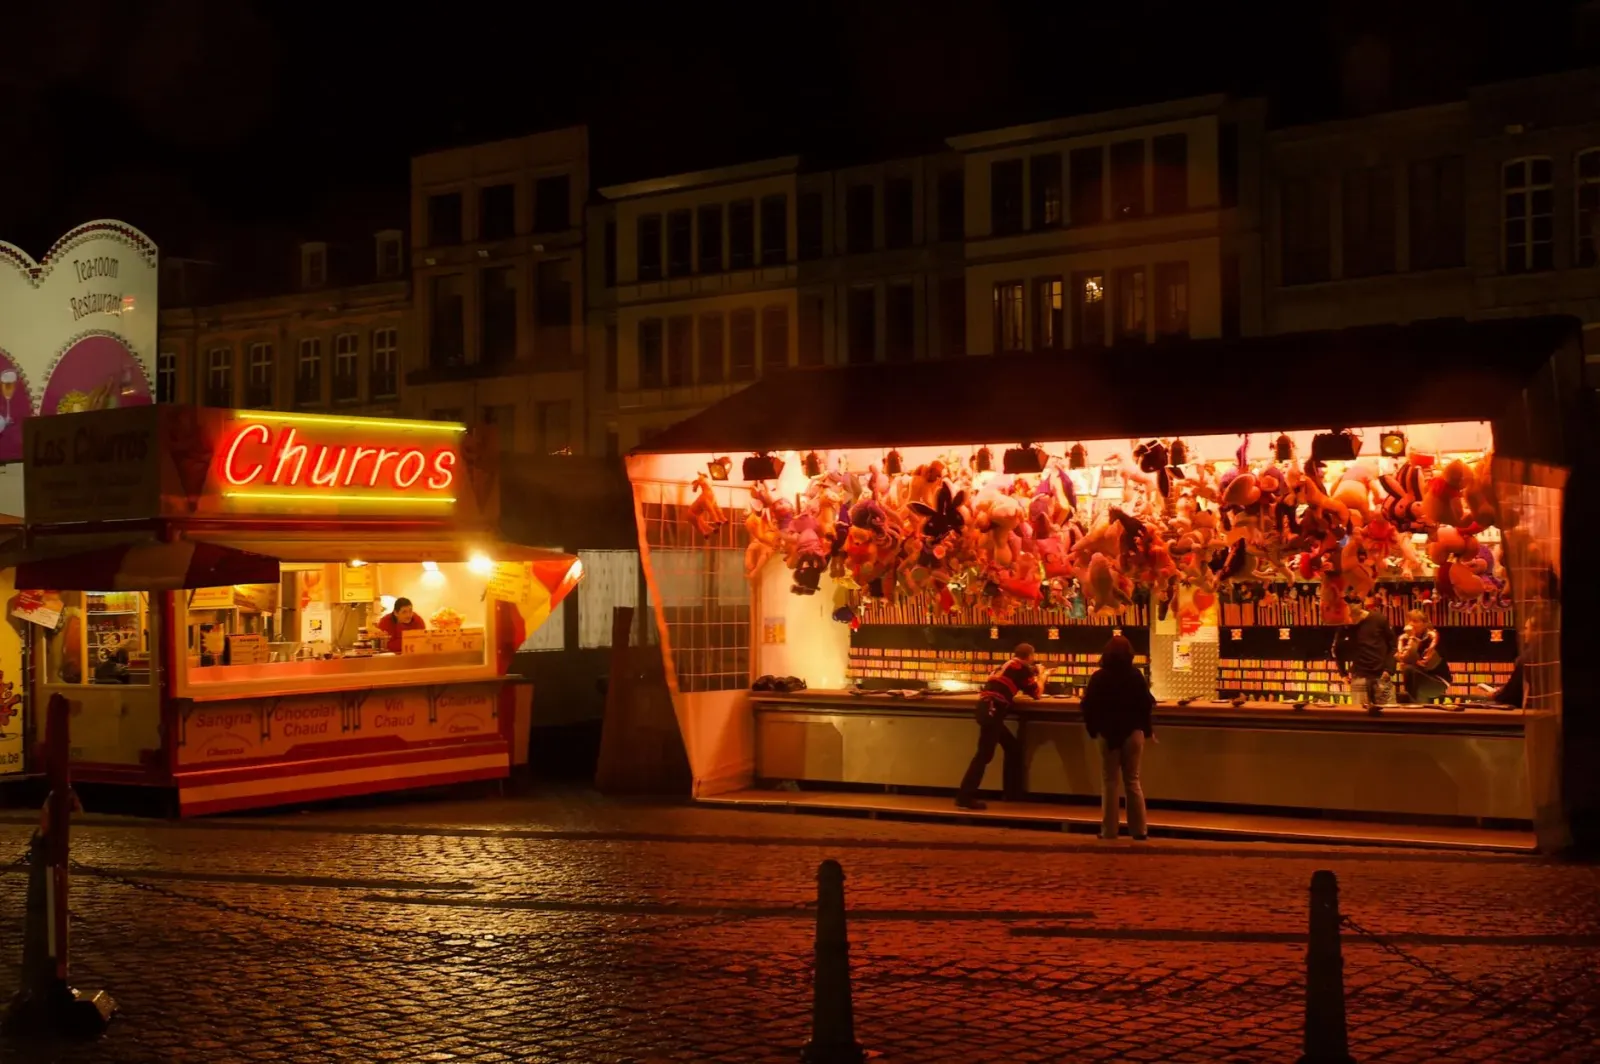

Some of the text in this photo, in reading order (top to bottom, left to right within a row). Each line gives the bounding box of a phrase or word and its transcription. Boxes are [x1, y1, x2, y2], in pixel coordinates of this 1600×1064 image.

[73, 257, 119, 283] Tea-room
[70, 293, 122, 321] Restaurant
[221, 423, 457, 490] Churros
[274, 704, 337, 722] Chocolat
[384, 699, 404, 712] Vin
[196, 713, 252, 730] Sangria
[283, 720, 328, 737] Chaud
[374, 713, 415, 728] Chaud
